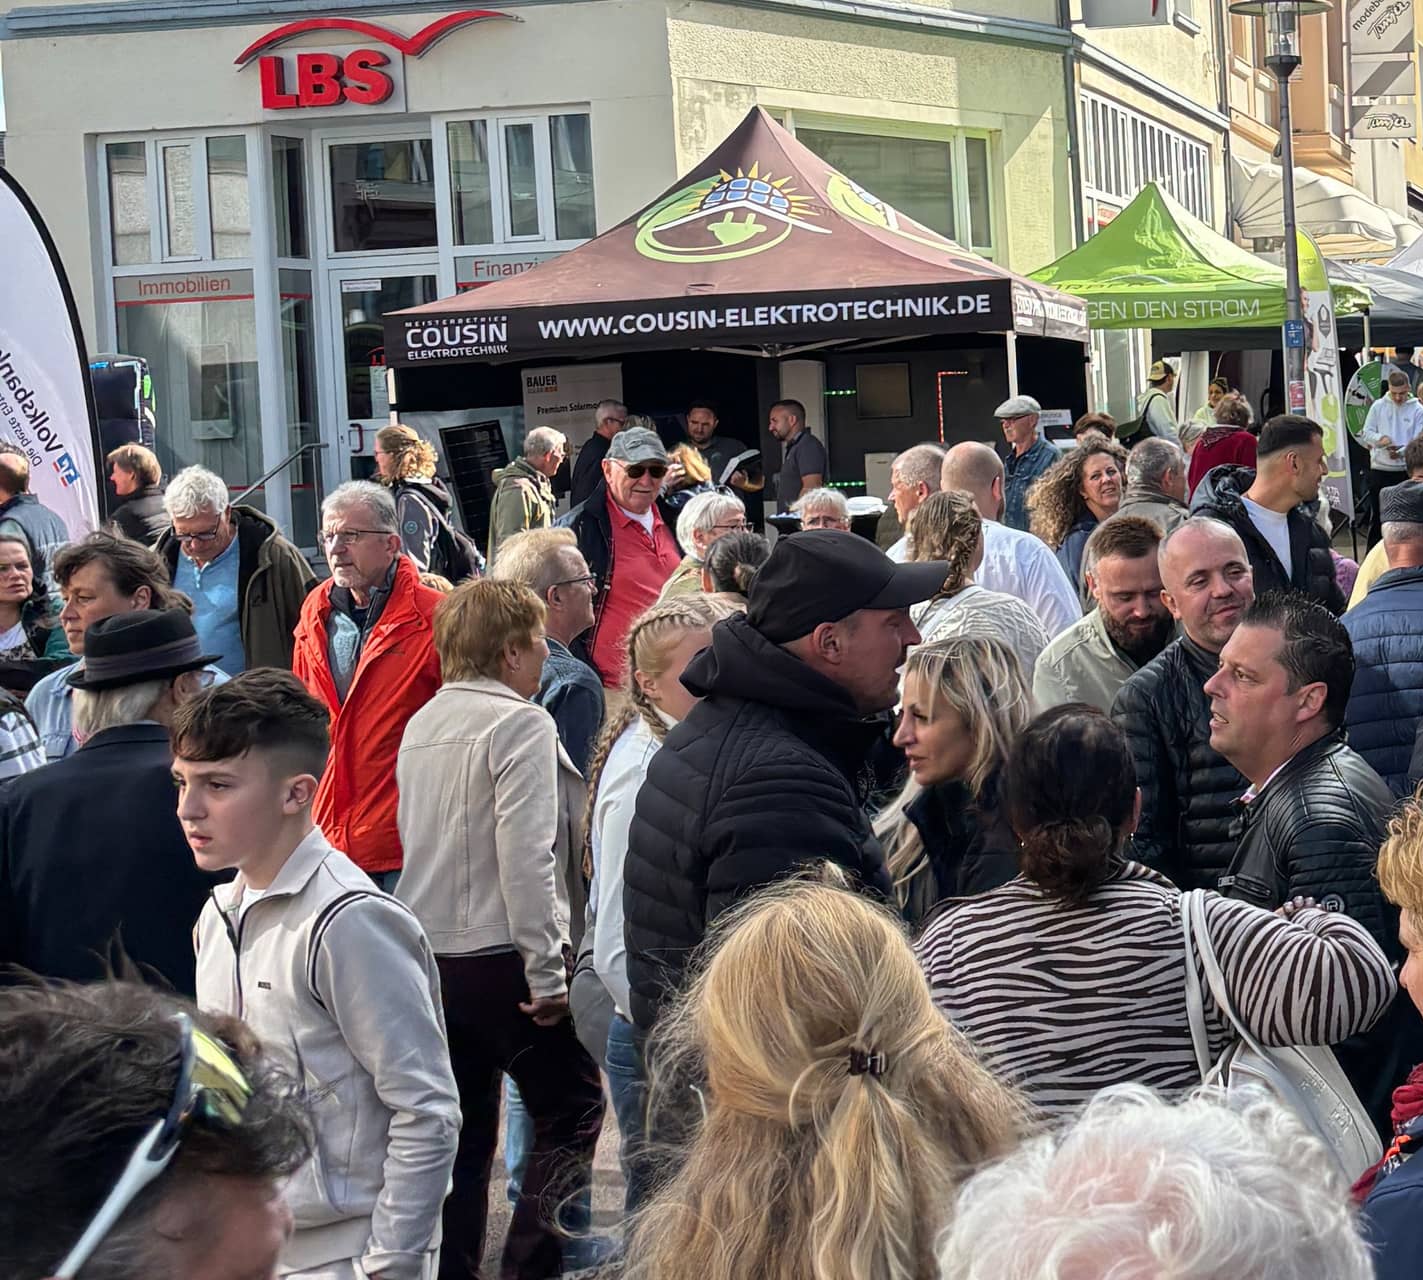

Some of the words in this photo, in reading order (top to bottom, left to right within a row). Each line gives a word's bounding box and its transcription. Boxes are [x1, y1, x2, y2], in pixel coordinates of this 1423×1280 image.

[258, 49, 395, 110] LBS
[138, 275, 231, 297] Immobilien
[538, 294, 991, 340] WWW.COUSIN-ELEKTROTECHNIK.DE
[1134, 300, 1177, 319] DEN
[1184, 299, 1260, 318] STROM
[407, 345, 509, 361] ELEKTROTECHNIK
[526, 375, 558, 388] BAUER
[537, 404, 568, 415] Premium
